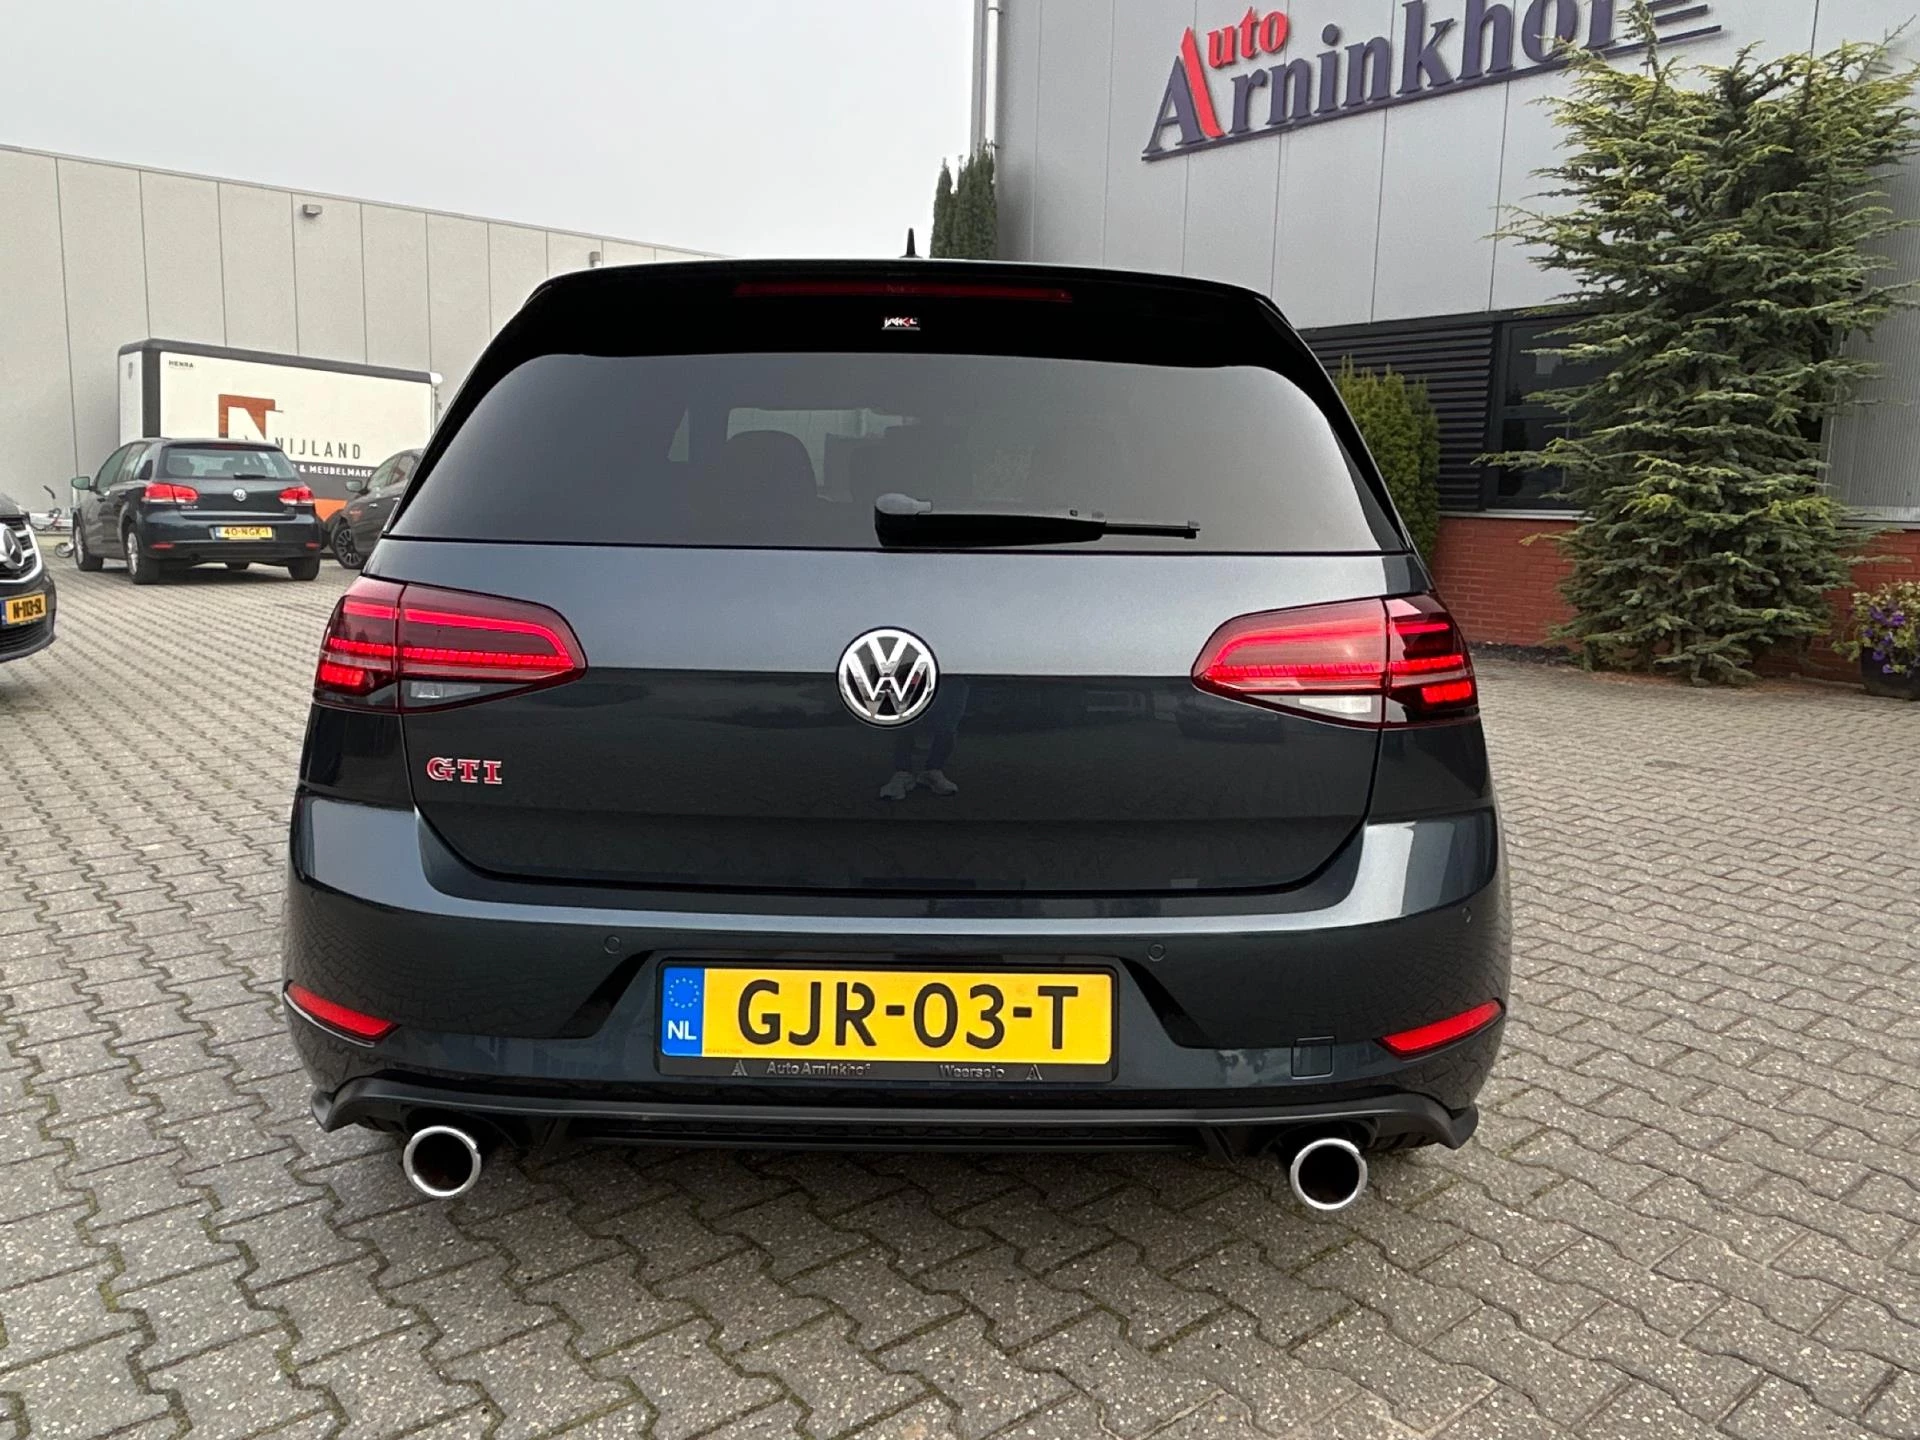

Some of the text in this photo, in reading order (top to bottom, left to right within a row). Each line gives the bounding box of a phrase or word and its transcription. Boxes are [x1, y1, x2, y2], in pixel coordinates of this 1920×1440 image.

[426, 756, 503, 785] GTI
[737, 979, 1079, 1050] GJR-03-T
[667, 1020, 697, 1041] NL
